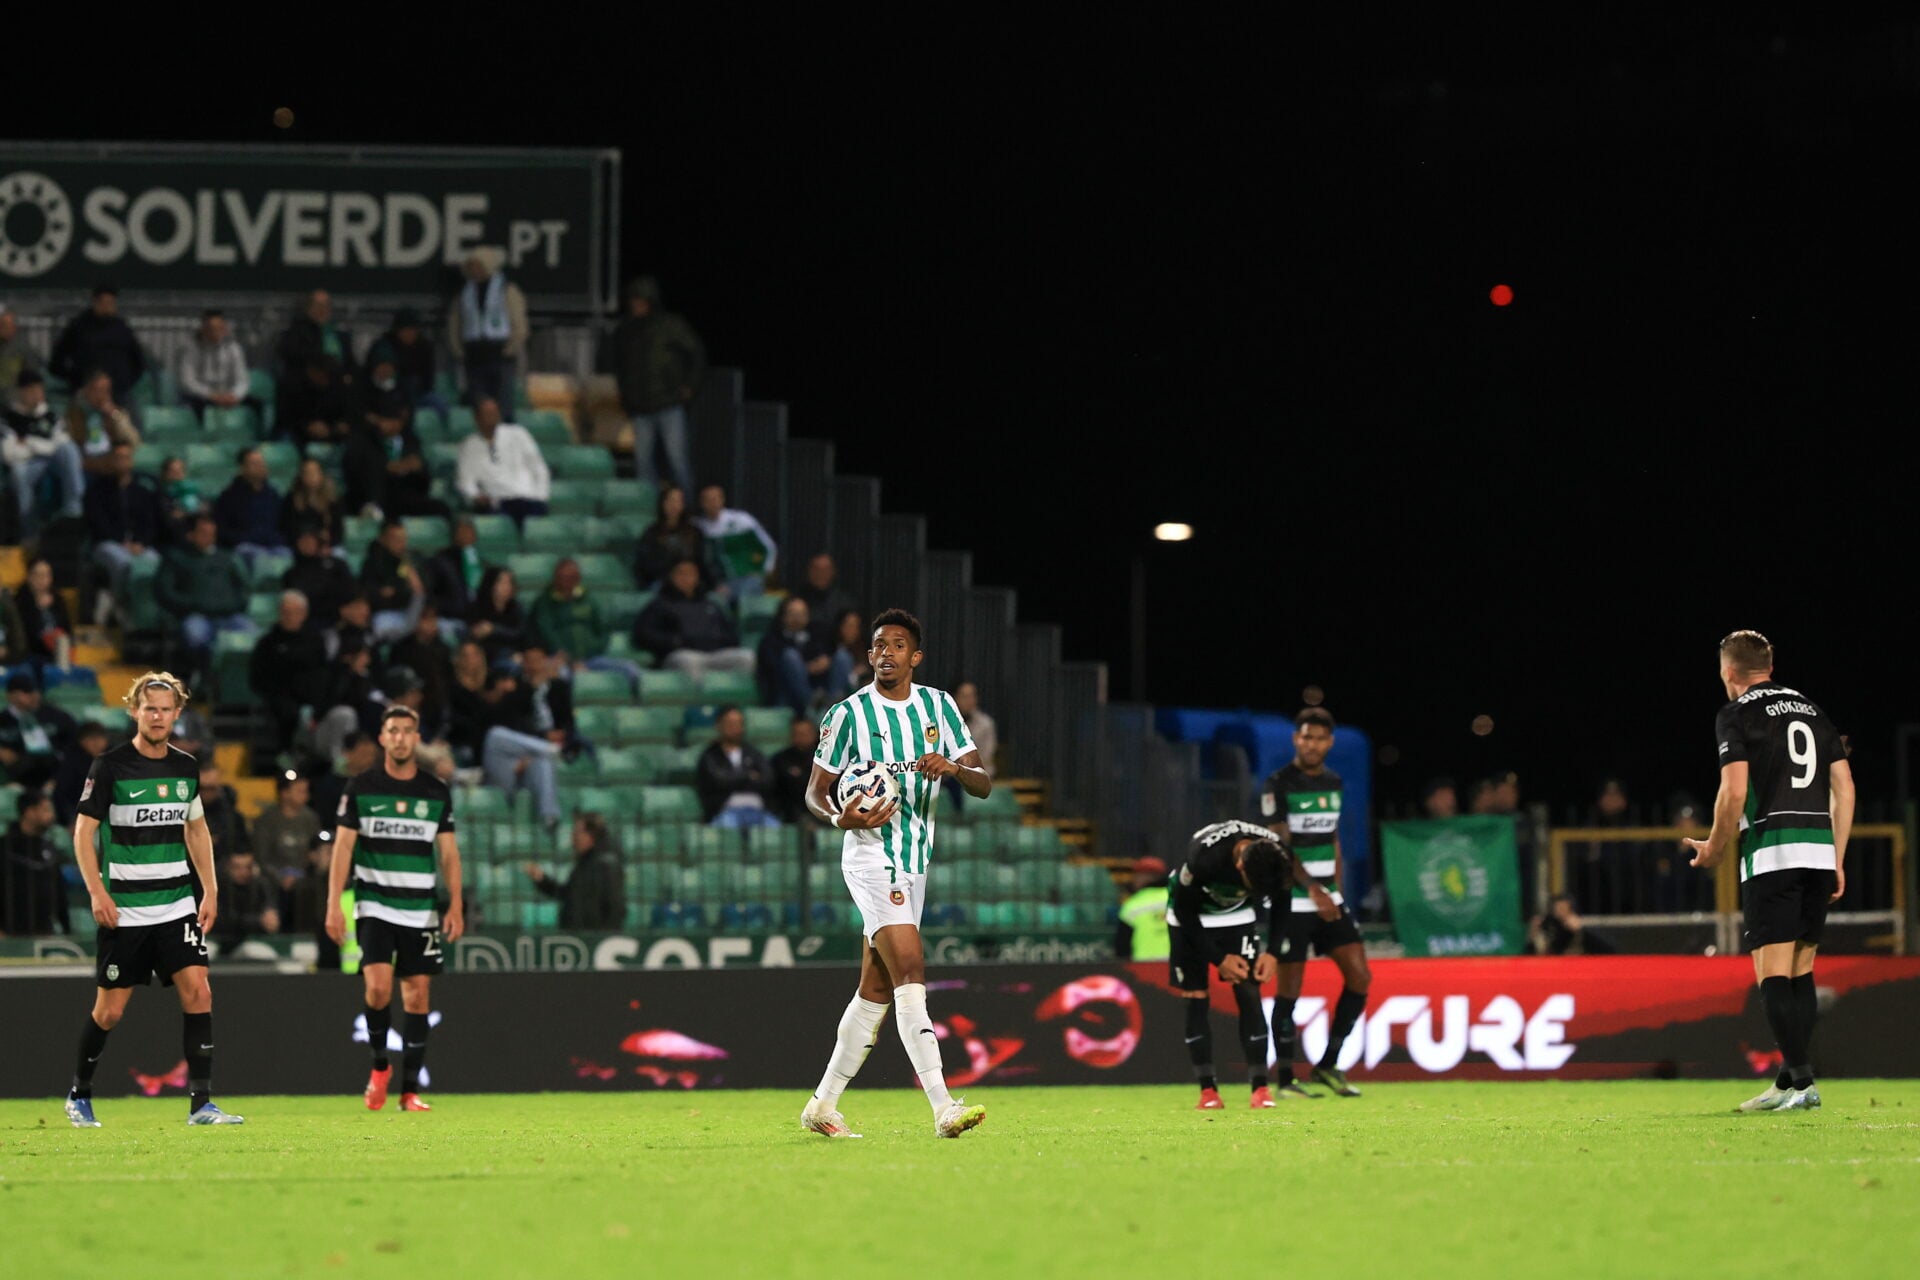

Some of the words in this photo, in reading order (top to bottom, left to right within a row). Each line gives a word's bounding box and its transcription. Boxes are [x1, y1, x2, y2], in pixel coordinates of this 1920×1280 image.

[1787, 720, 1817, 789] 9
[373, 820, 425, 836] Betano
[884, 866, 897, 884] 7
